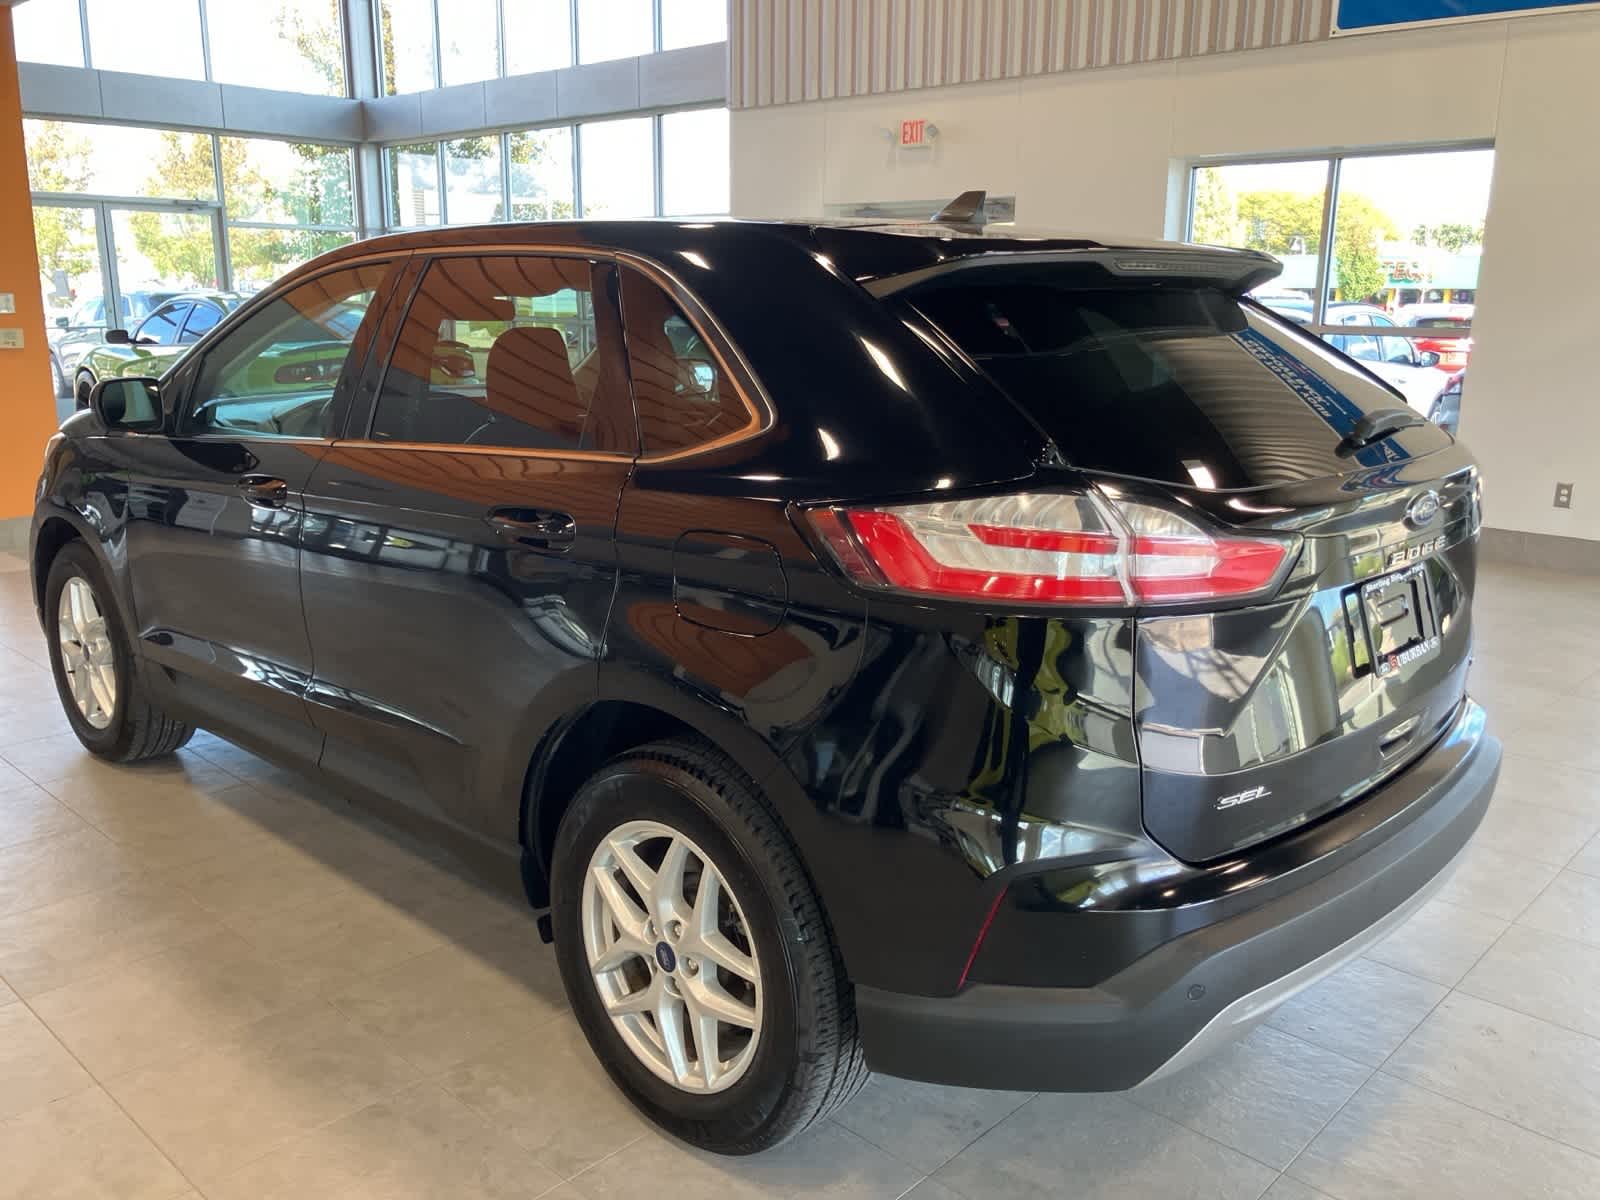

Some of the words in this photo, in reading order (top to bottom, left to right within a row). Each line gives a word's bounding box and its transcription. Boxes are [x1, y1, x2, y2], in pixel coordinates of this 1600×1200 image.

[901, 119, 926, 144] EXIT
[1390, 535, 1446, 565] EDGE
[1216, 786, 1272, 810] SEL
